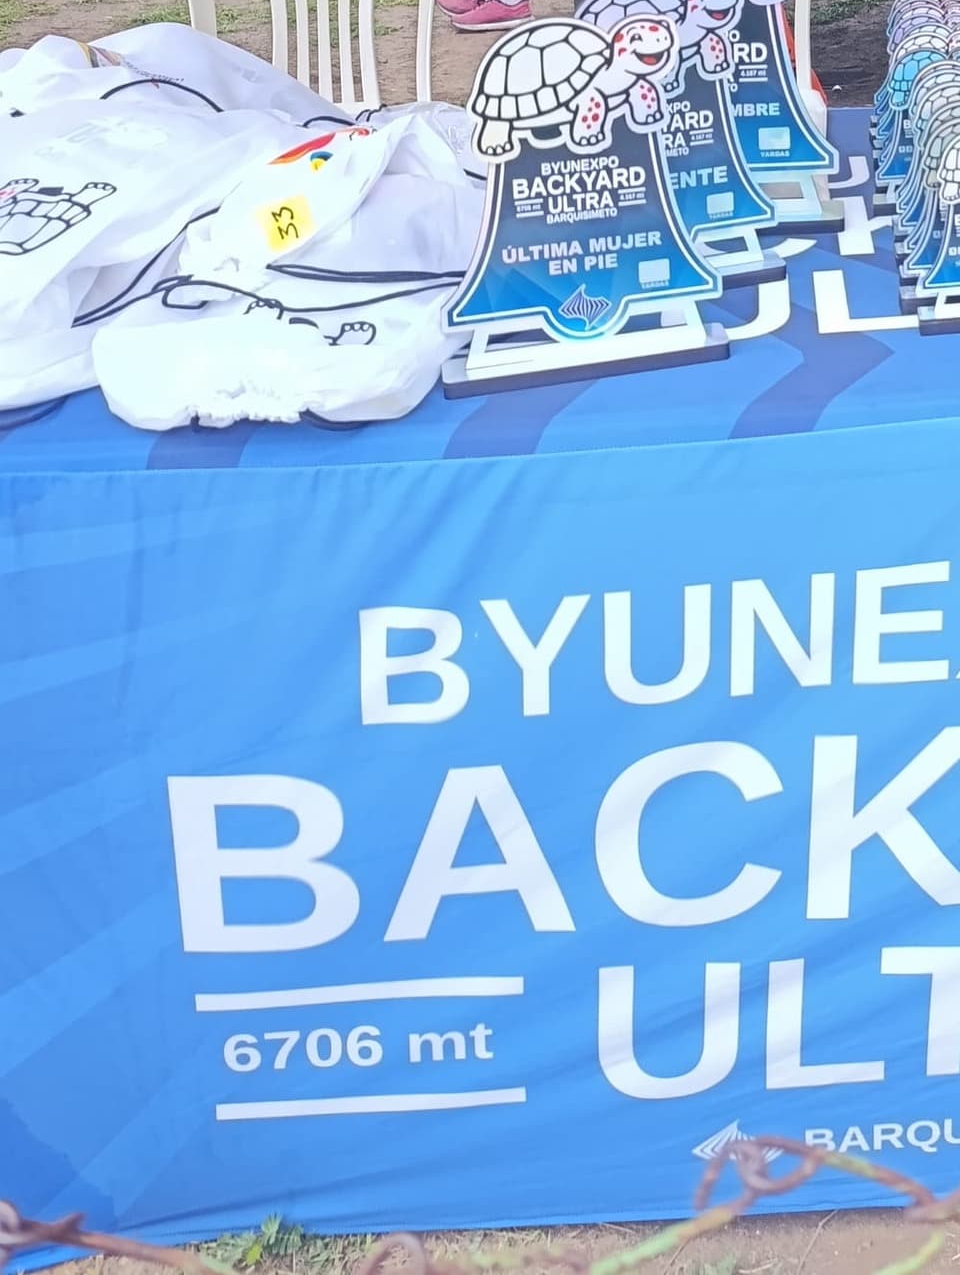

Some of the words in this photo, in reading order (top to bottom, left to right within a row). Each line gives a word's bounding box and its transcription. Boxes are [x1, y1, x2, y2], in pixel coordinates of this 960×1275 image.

[541, 155, 619, 176] BYUNEXPO
[512, 166, 647, 200] BACKYARD
[548, 190, 614, 214] ULTRA
[546, 207, 618, 225] BARQUISIMETO
[502, 239, 584, 264] ÚLTIMA
[589, 230, 662, 253] MUJER
[548, 258, 578, 276] EN
[584, 252, 619, 272] PIE
[223, 1025, 384, 1073] 6706
[408, 1022, 495, 1064] mt
